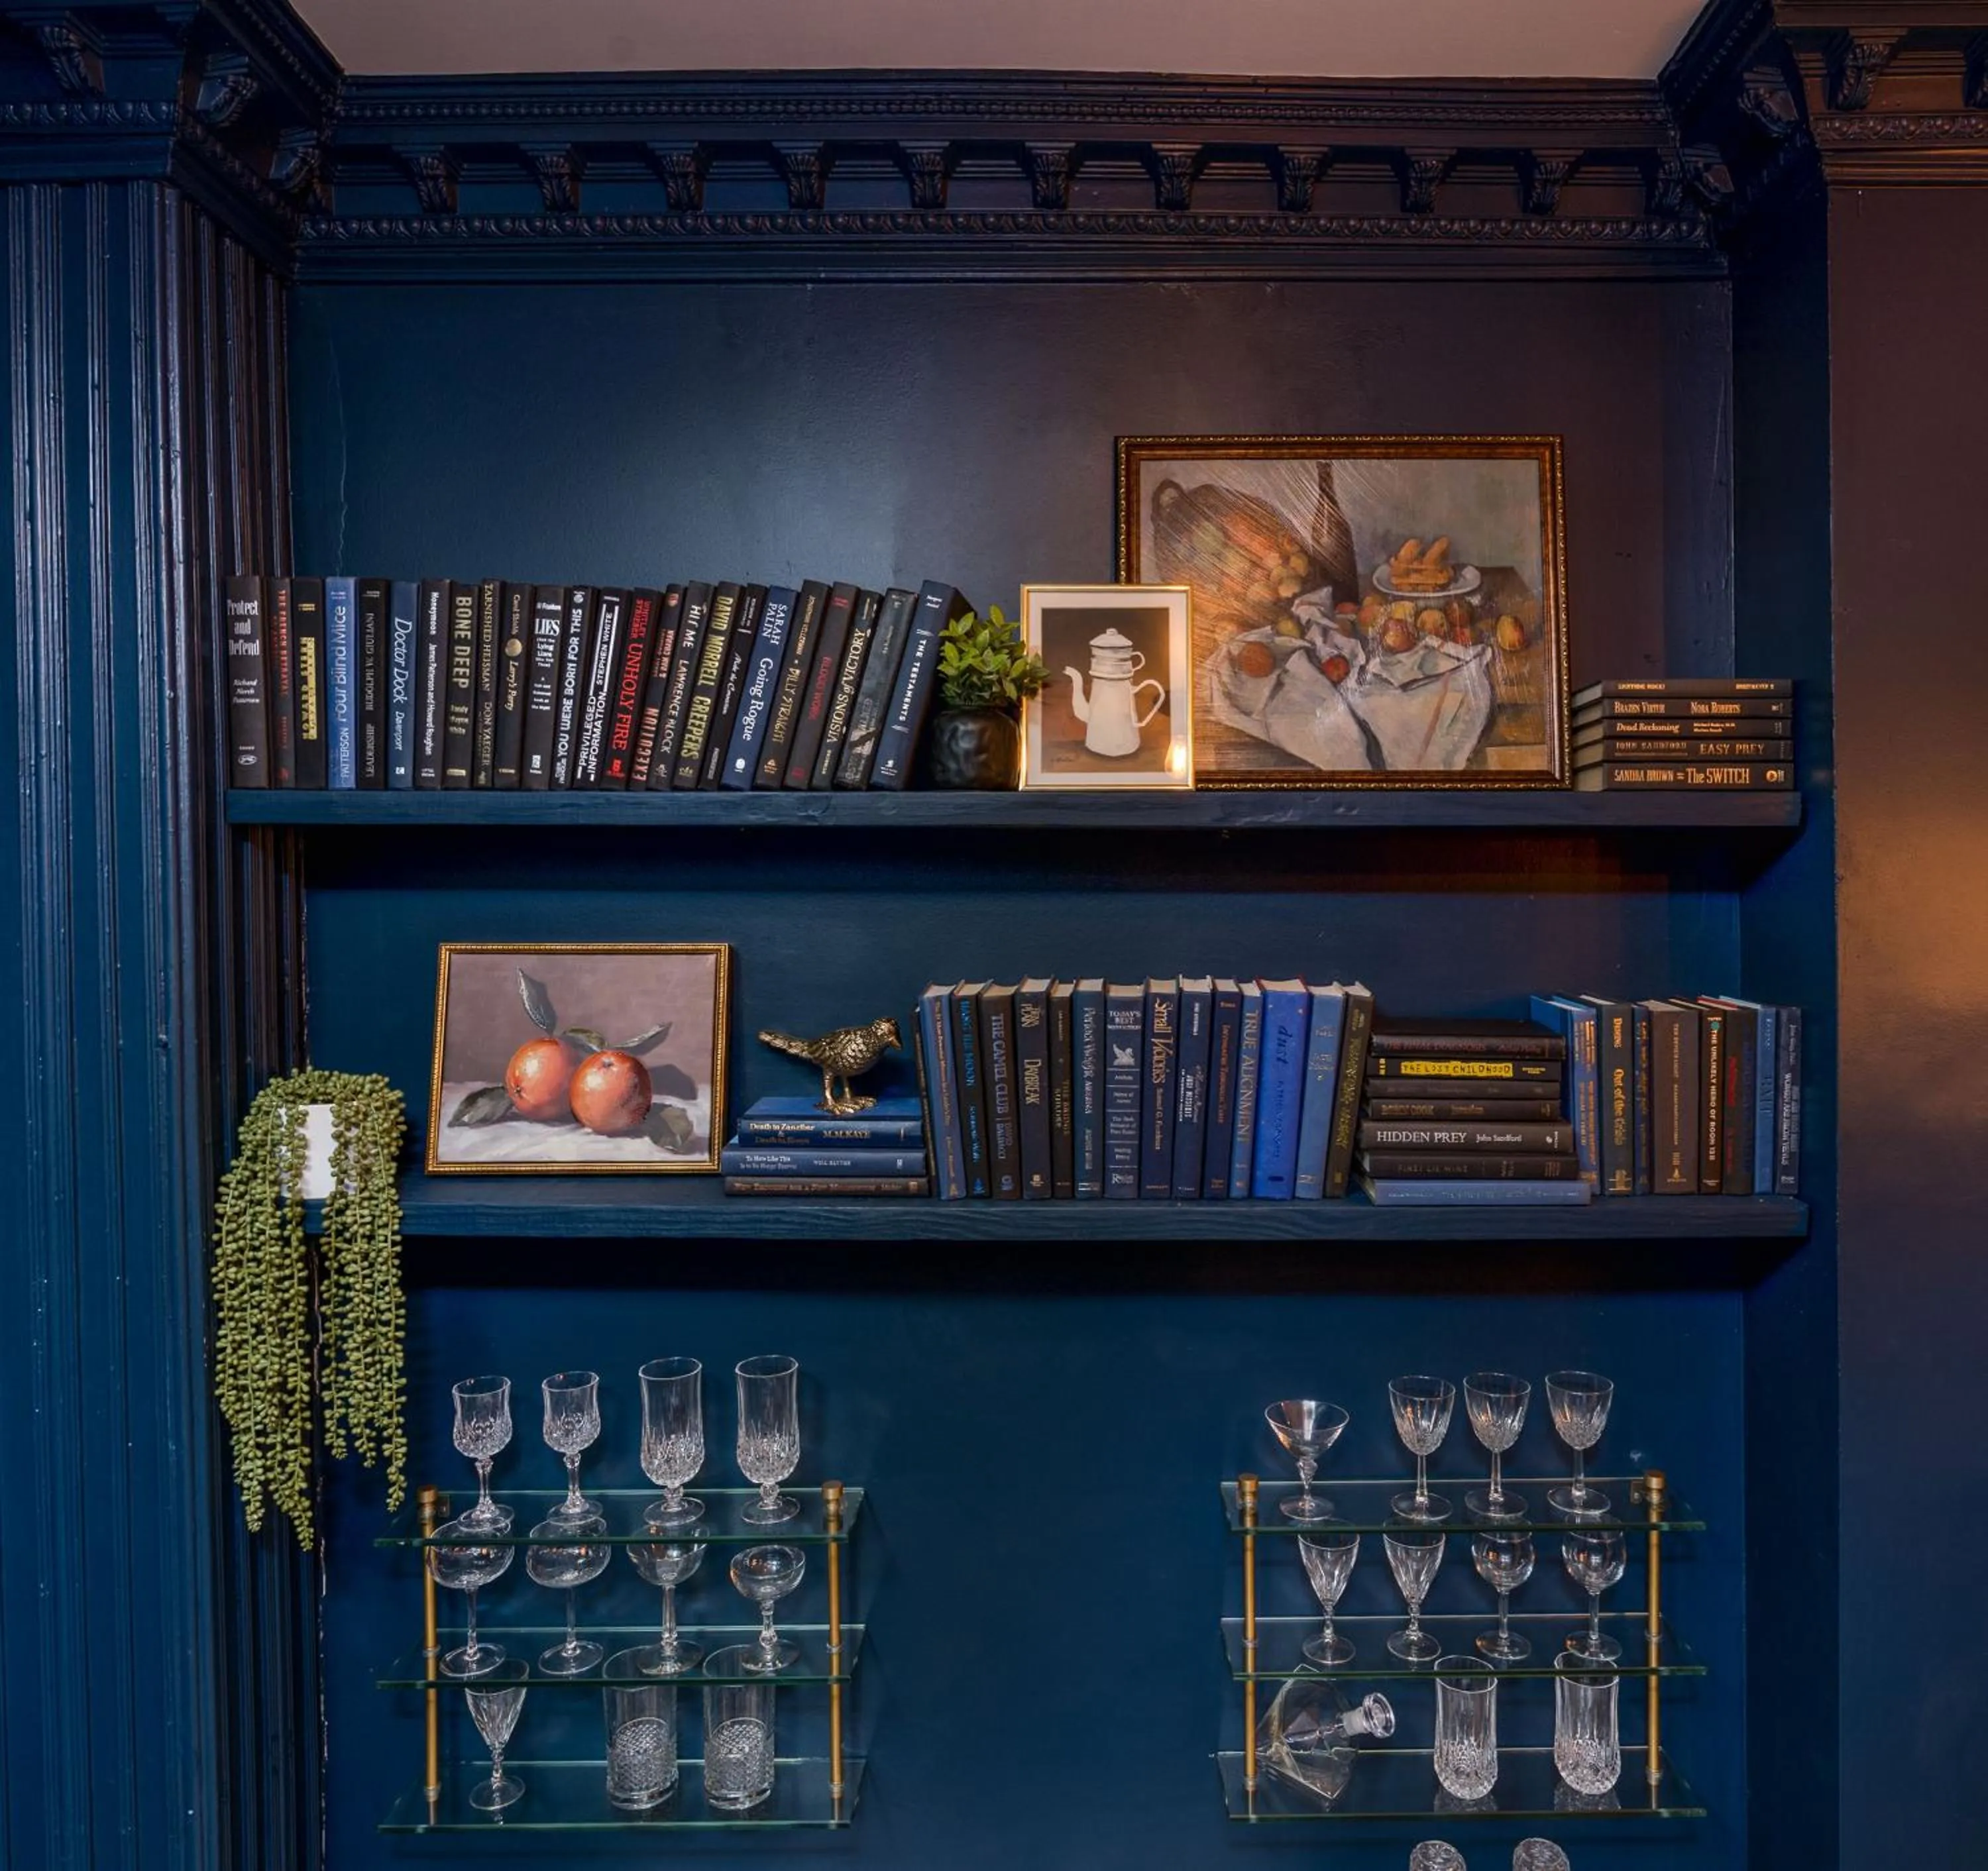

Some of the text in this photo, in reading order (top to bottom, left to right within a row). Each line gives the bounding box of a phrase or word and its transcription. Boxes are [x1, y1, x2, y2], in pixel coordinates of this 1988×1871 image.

[227, 600, 258, 615] Protect
[333, 605, 347, 644] Mice
[429, 592, 439, 635] Honeymoon
[570, 608, 582, 633] THIS
[762, 602, 778, 638] PALIN
[769, 604, 787, 645] SARAH
[234, 618, 251, 635] and
[452, 596, 472, 689] BONE DEEP
[482, 583, 494, 692] TARNISHED HEISMAN
[535, 618, 560, 636] LIES
[682, 604, 702, 648] HIT ME
[697, 596, 734, 686] DAVID MORRELL
[229, 639, 260, 656] Defend
[332, 645, 347, 685] Blind
[392, 617, 412, 704] Doctor Dock
[427, 643, 437, 663] James
[566, 636, 579, 661] FOR
[596, 612, 613, 685] STEPHEN WHITE
[842, 628, 866, 681] VICTORY
[427, 663, 436, 692] Patterson
[504, 661, 518, 711] Larry's Party
[563, 663, 577, 696] BORN
[841, 680, 856, 695] of
[899, 639, 927, 722] THE TESTAMENTS
[426, 692, 435, 703] and
[560, 698, 574, 731] WERE
[612, 643, 643, 751] UNHOLY FIRE
[661, 660, 689, 753] LAWRENCE BLOCK
[743, 657, 775, 741] Going Rogue
[772, 667, 801, 744] BILLY STRAIGHT
[1614, 702, 1666, 714] BRAZEN VIRTUE
[1690, 702, 1741, 714] NORA ROBERTS
[394, 711, 405, 751] Davenport
[425, 704, 435, 727] Howard
[578, 696, 596, 767] PRIVILEGED
[587, 691, 606, 774] INFORMATION
[681, 695, 711, 759] CREEPERS
[826, 694, 850, 743] VISIONS
[1616, 722, 1680, 733] Dead Reckoning
[482, 702, 492, 766] DON YAEGER
[558, 733, 571, 757] YOU
[632, 707, 659, 781] EXECUTION
[1700, 743, 1765, 755] EASY PREY
[1614, 769, 1674, 782] SANDRA BROWN
[1686, 768, 1750, 784] The SWITCH
[1151, 997, 1174, 1084] Small Victories
[1276, 1026, 1293, 1065] dust
[964, 1052, 975, 1087] MOON
[991, 1013, 1009, 1114] THE CAMEL CLUB
[1237, 1009, 1258, 1143] TRUE ALIGNMENT
[1452, 1063, 1511, 1074] CHILDHOOD
[1613, 1068, 1624, 1086] Out
[1024, 1059, 1042, 1105] DAYBREAK
[1614, 1087, 1626, 1099] of
[1614, 1099, 1626, 1117] the
[1709, 1108, 1716, 1120] OF
[781, 1122, 815, 1131] Zanzibar
[1377, 1130, 1467, 1144] HIDDEN PREY
[1476, 1133, 1523, 1143] John Sandford
